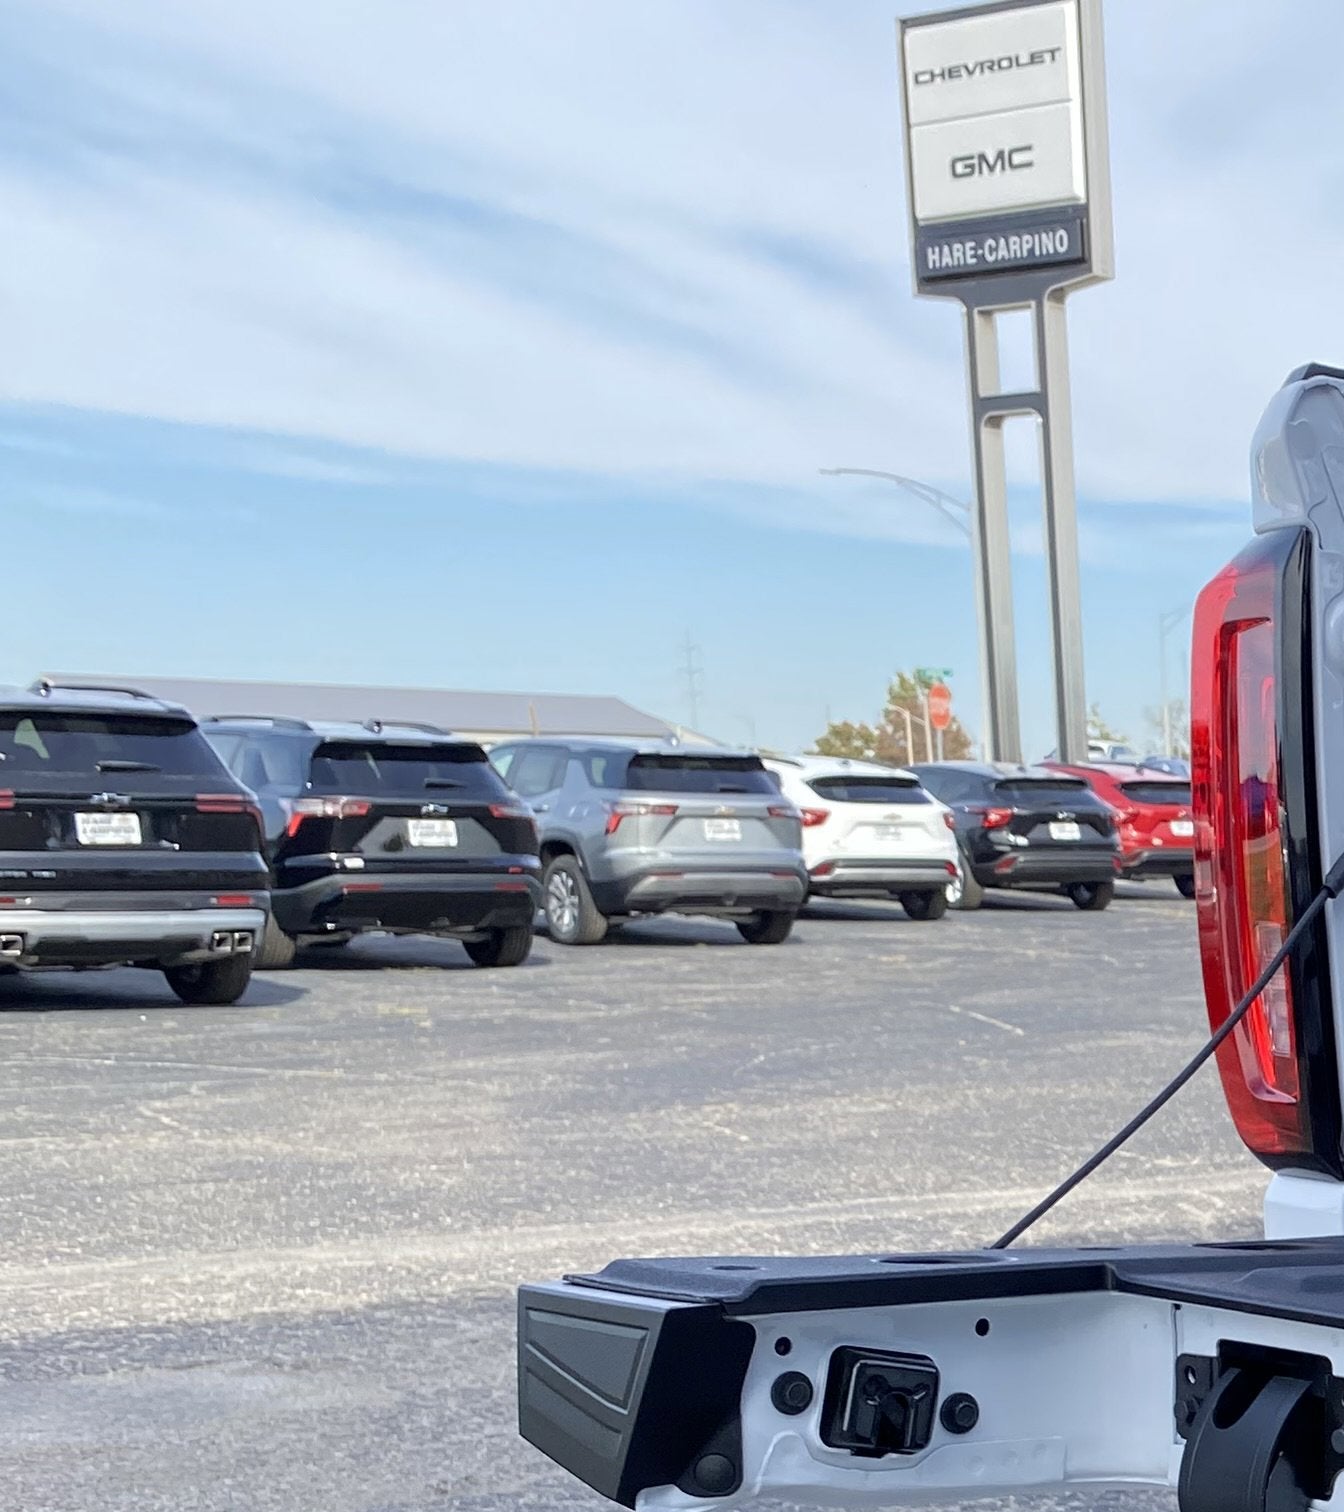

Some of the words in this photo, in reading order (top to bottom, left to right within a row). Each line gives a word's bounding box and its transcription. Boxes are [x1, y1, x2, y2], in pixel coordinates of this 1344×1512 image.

[913, 47, 1062, 85] CHEVROLET
[951, 145, 1034, 179] GMC
[926, 228, 1069, 269] HARE-CARPINO
